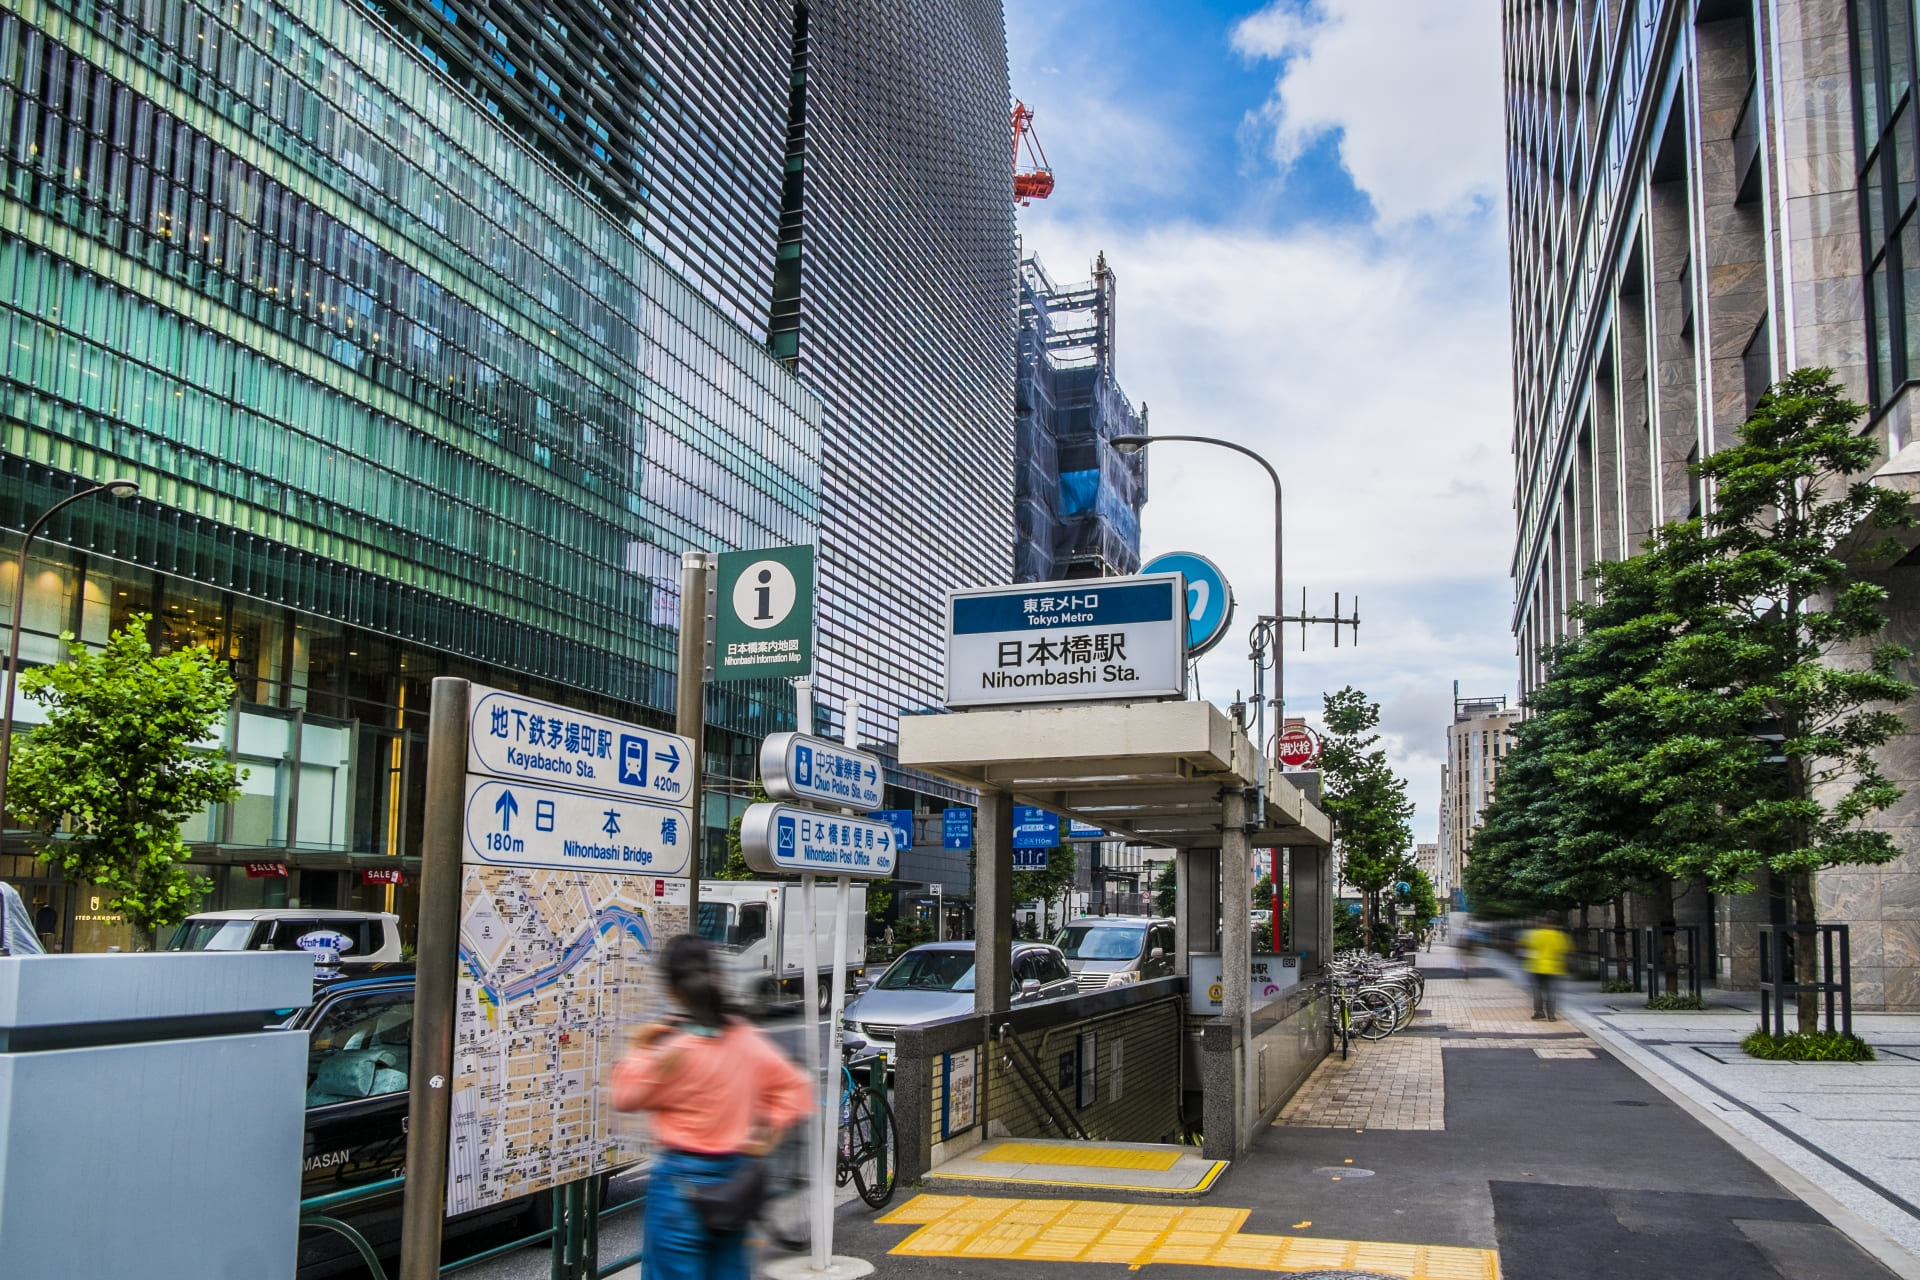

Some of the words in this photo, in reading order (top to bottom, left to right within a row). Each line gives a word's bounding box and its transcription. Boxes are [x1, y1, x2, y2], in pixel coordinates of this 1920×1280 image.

[1023, 594, 1098, 613] 東京メトロ
[1028, 614, 1059, 627] Tokyo
[1061, 612, 1093, 623] Metro
[728, 639, 799, 655] 日本橋案内地図
[998, 632, 1127, 668] 日本橋駅
[724, 654, 756, 666] Nihonbashi
[756, 653, 788, 664] Information
[788, 652, 802, 664] Map
[982, 667, 1097, 689] Nihombashi
[1102, 664, 1140, 682] Sta.
[490, 704, 612, 760] 地下鉄茅場町駅
[1279, 740, 1311, 757] 消火栓
[507, 747, 572, 774] Kayabacho
[576, 759, 596, 779] Sta.
[815, 750, 861, 782] 中央警察署
[653, 775, 680, 793] 420m
[814, 774, 830, 790] Chuo
[832, 779, 849, 796] Police
[863, 789, 878, 802] 450m
[486, 832, 524, 853] 180m
[801, 819, 873, 850] 日本橋郵便局
[563, 840, 620, 861] Nihonbashi
[623, 845, 653, 866] Bridge
[804, 845, 838, 863] Nihonbashi
[839, 849, 852, 863] Post
[854, 850, 870, 865] Office
[876, 857, 890, 868] 450m
[250, 863, 277, 872] SALE
[367, 870, 391, 879] SALE
